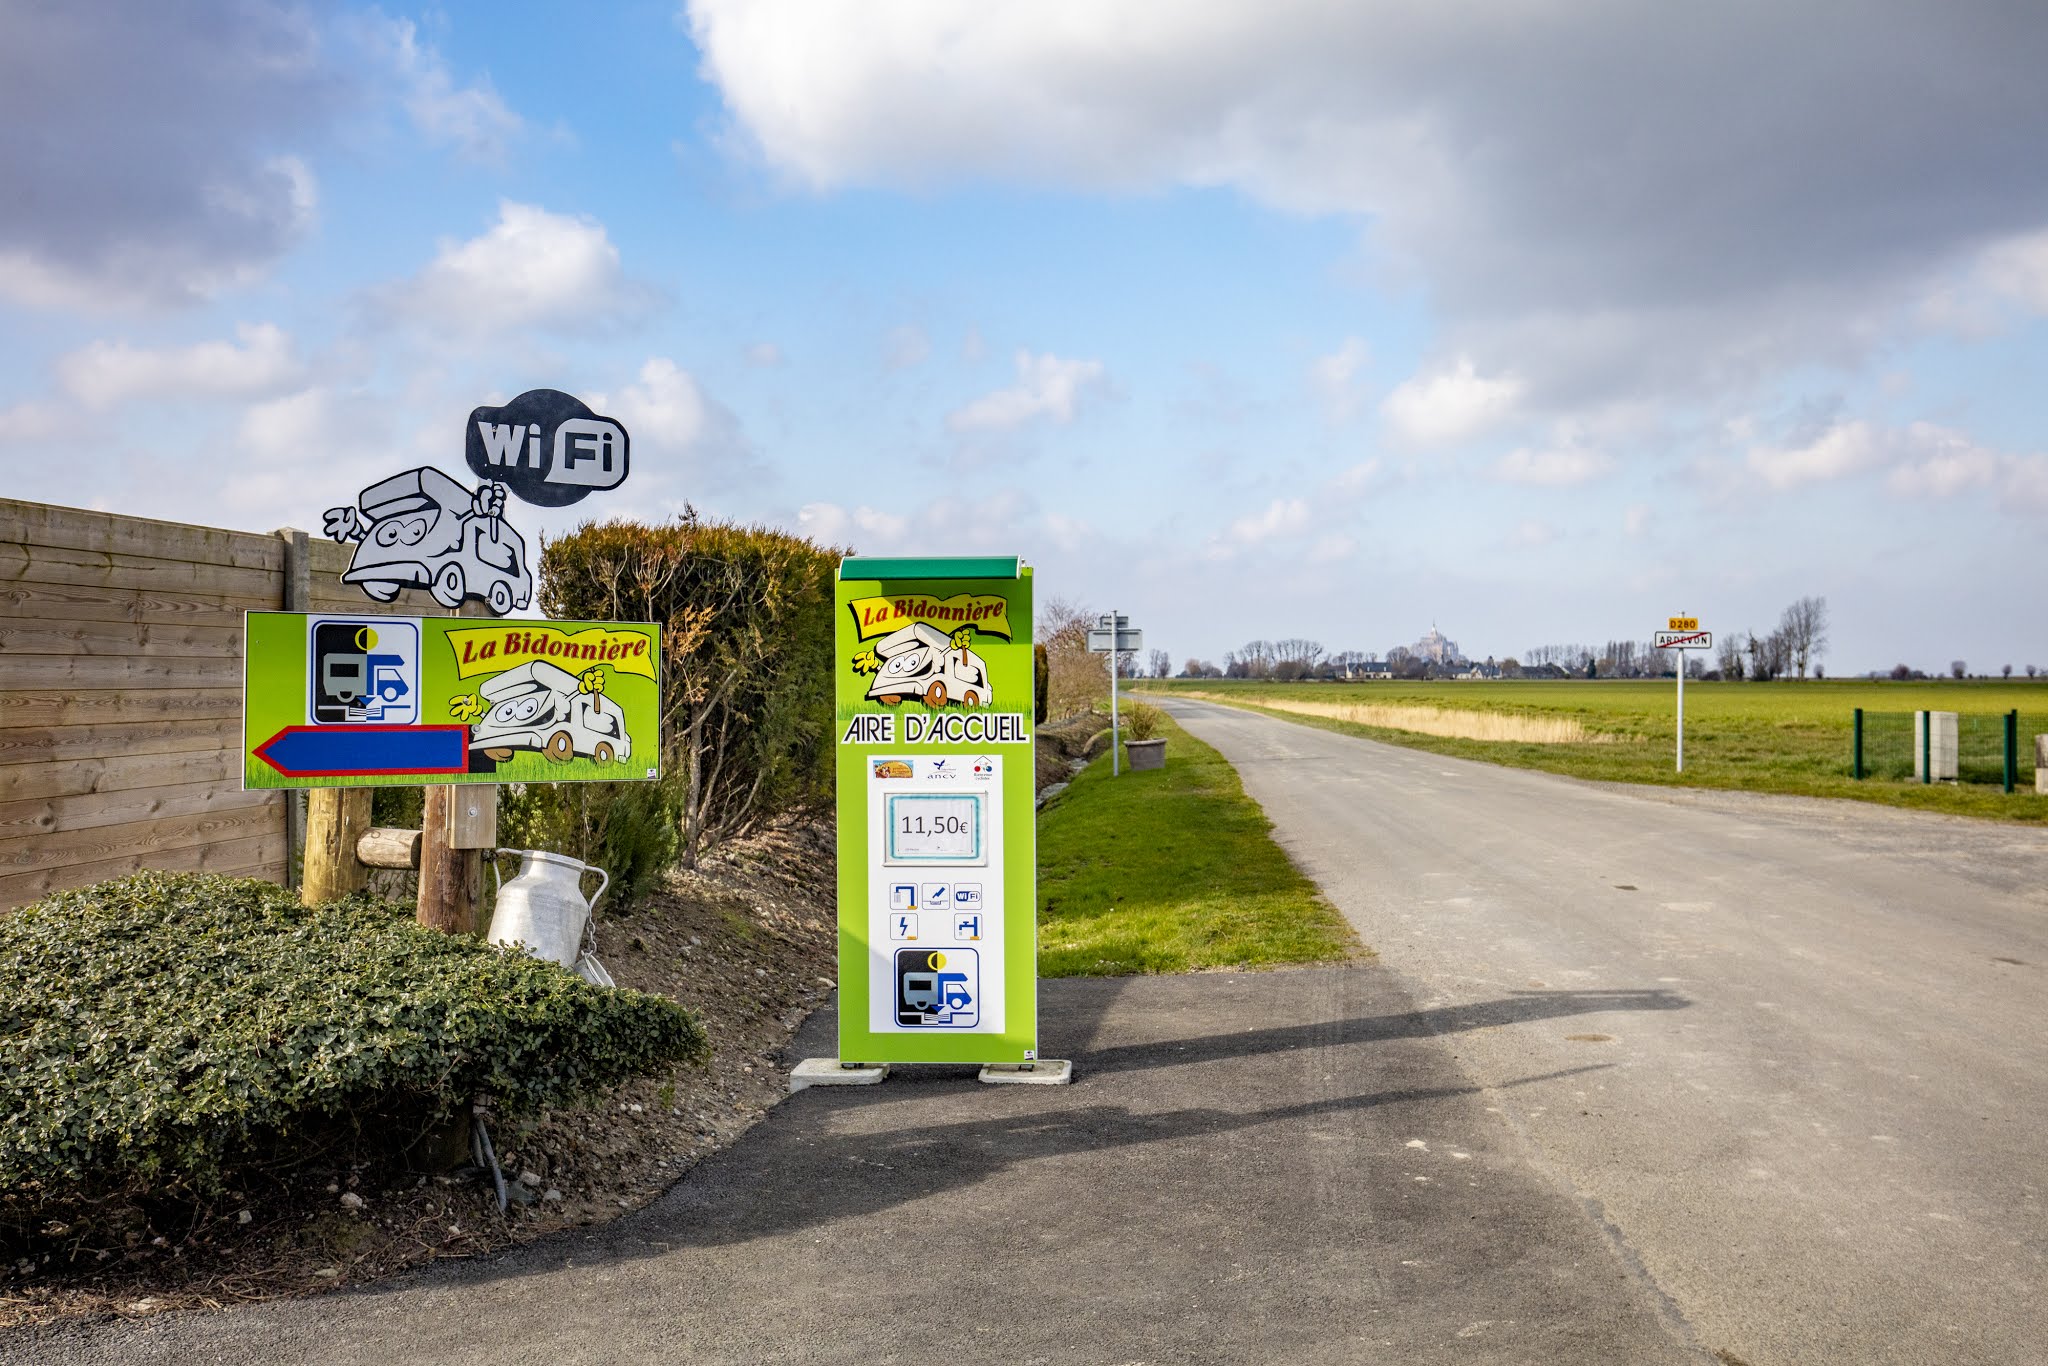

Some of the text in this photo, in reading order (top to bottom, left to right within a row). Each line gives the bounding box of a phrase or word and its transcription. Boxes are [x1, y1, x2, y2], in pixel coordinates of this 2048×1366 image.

[863, 599, 1004, 627] La Bidonnière
[1670, 620, 1696, 629] D280
[463, 631, 648, 666] La Bidonnière
[1660, 636, 1707, 645] ARDEVON
[843, 715, 1027, 742] AIRE D'ACCUEIL
[901, 815, 969, 838] 11,50€
